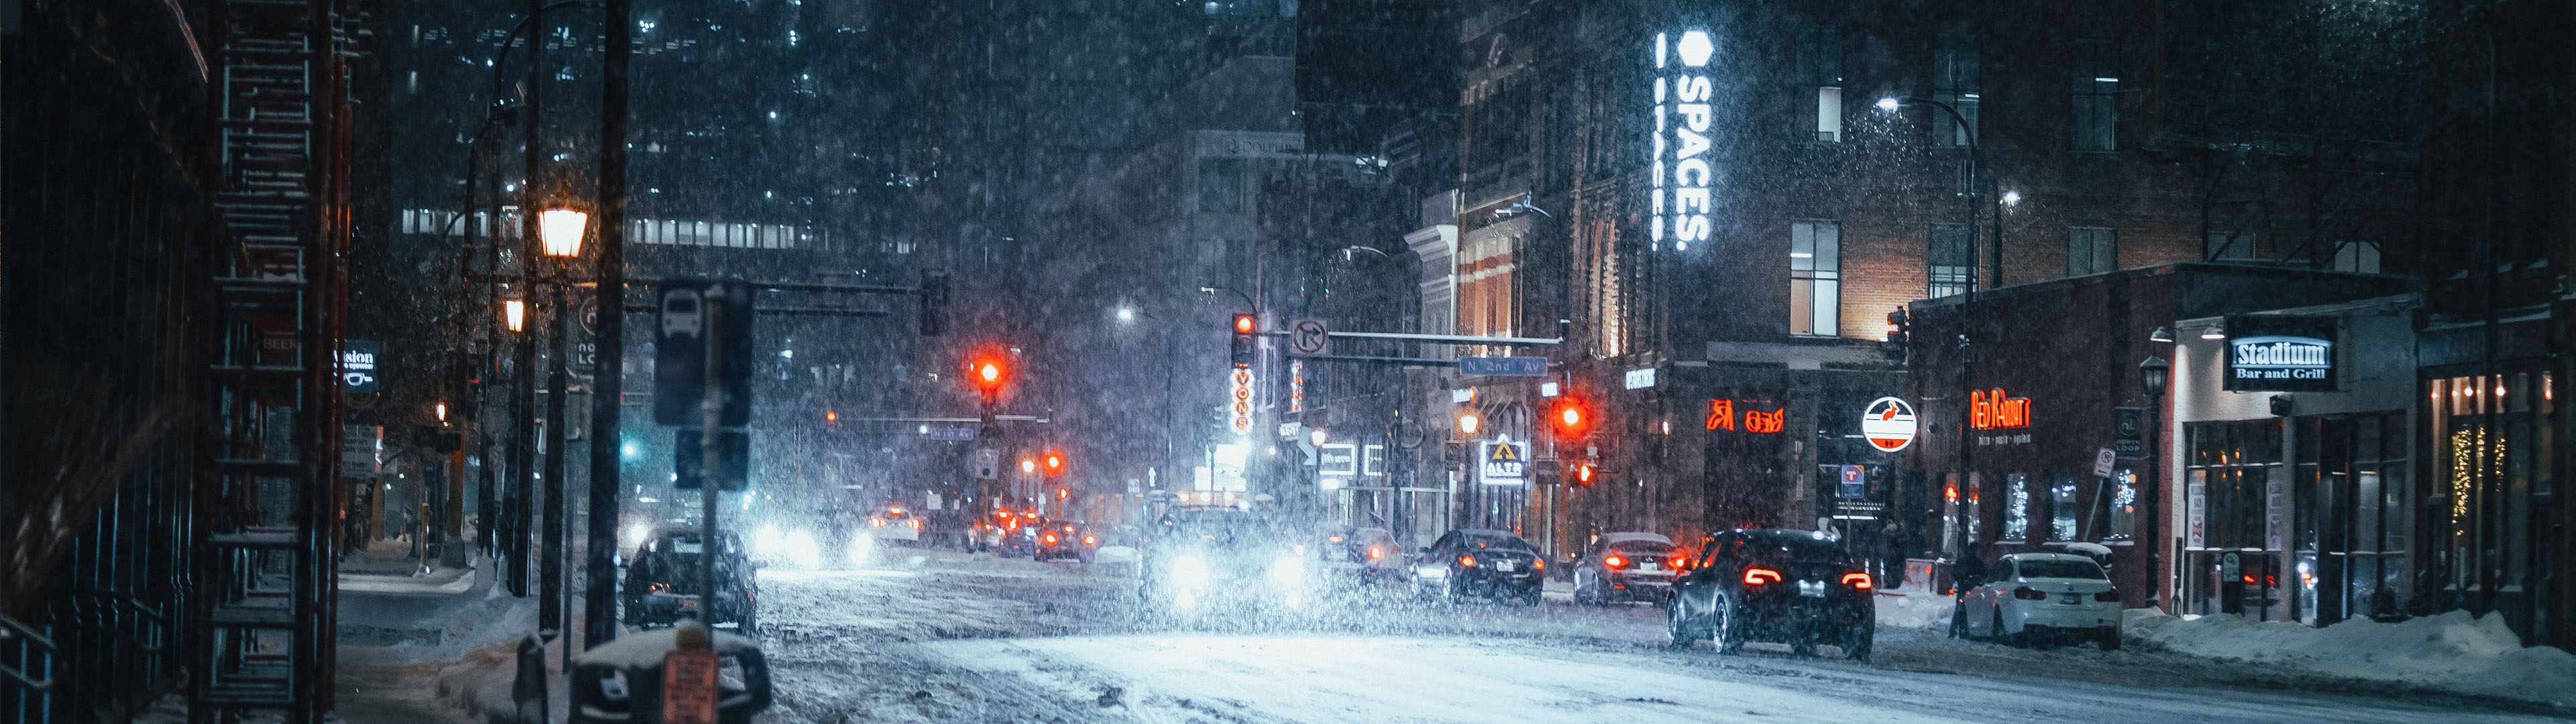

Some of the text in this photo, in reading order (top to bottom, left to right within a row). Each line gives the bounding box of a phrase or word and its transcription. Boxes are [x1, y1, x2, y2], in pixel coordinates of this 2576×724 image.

[1675, 74, 1711, 251] SPACES.
[2238, 342, 2325, 365] Stadium
[1468, 361, 1539, 371] N 2nd Av
[2237, 368, 2326, 379] Bar and Grill
[1236, 363, 1249, 428] YONS
